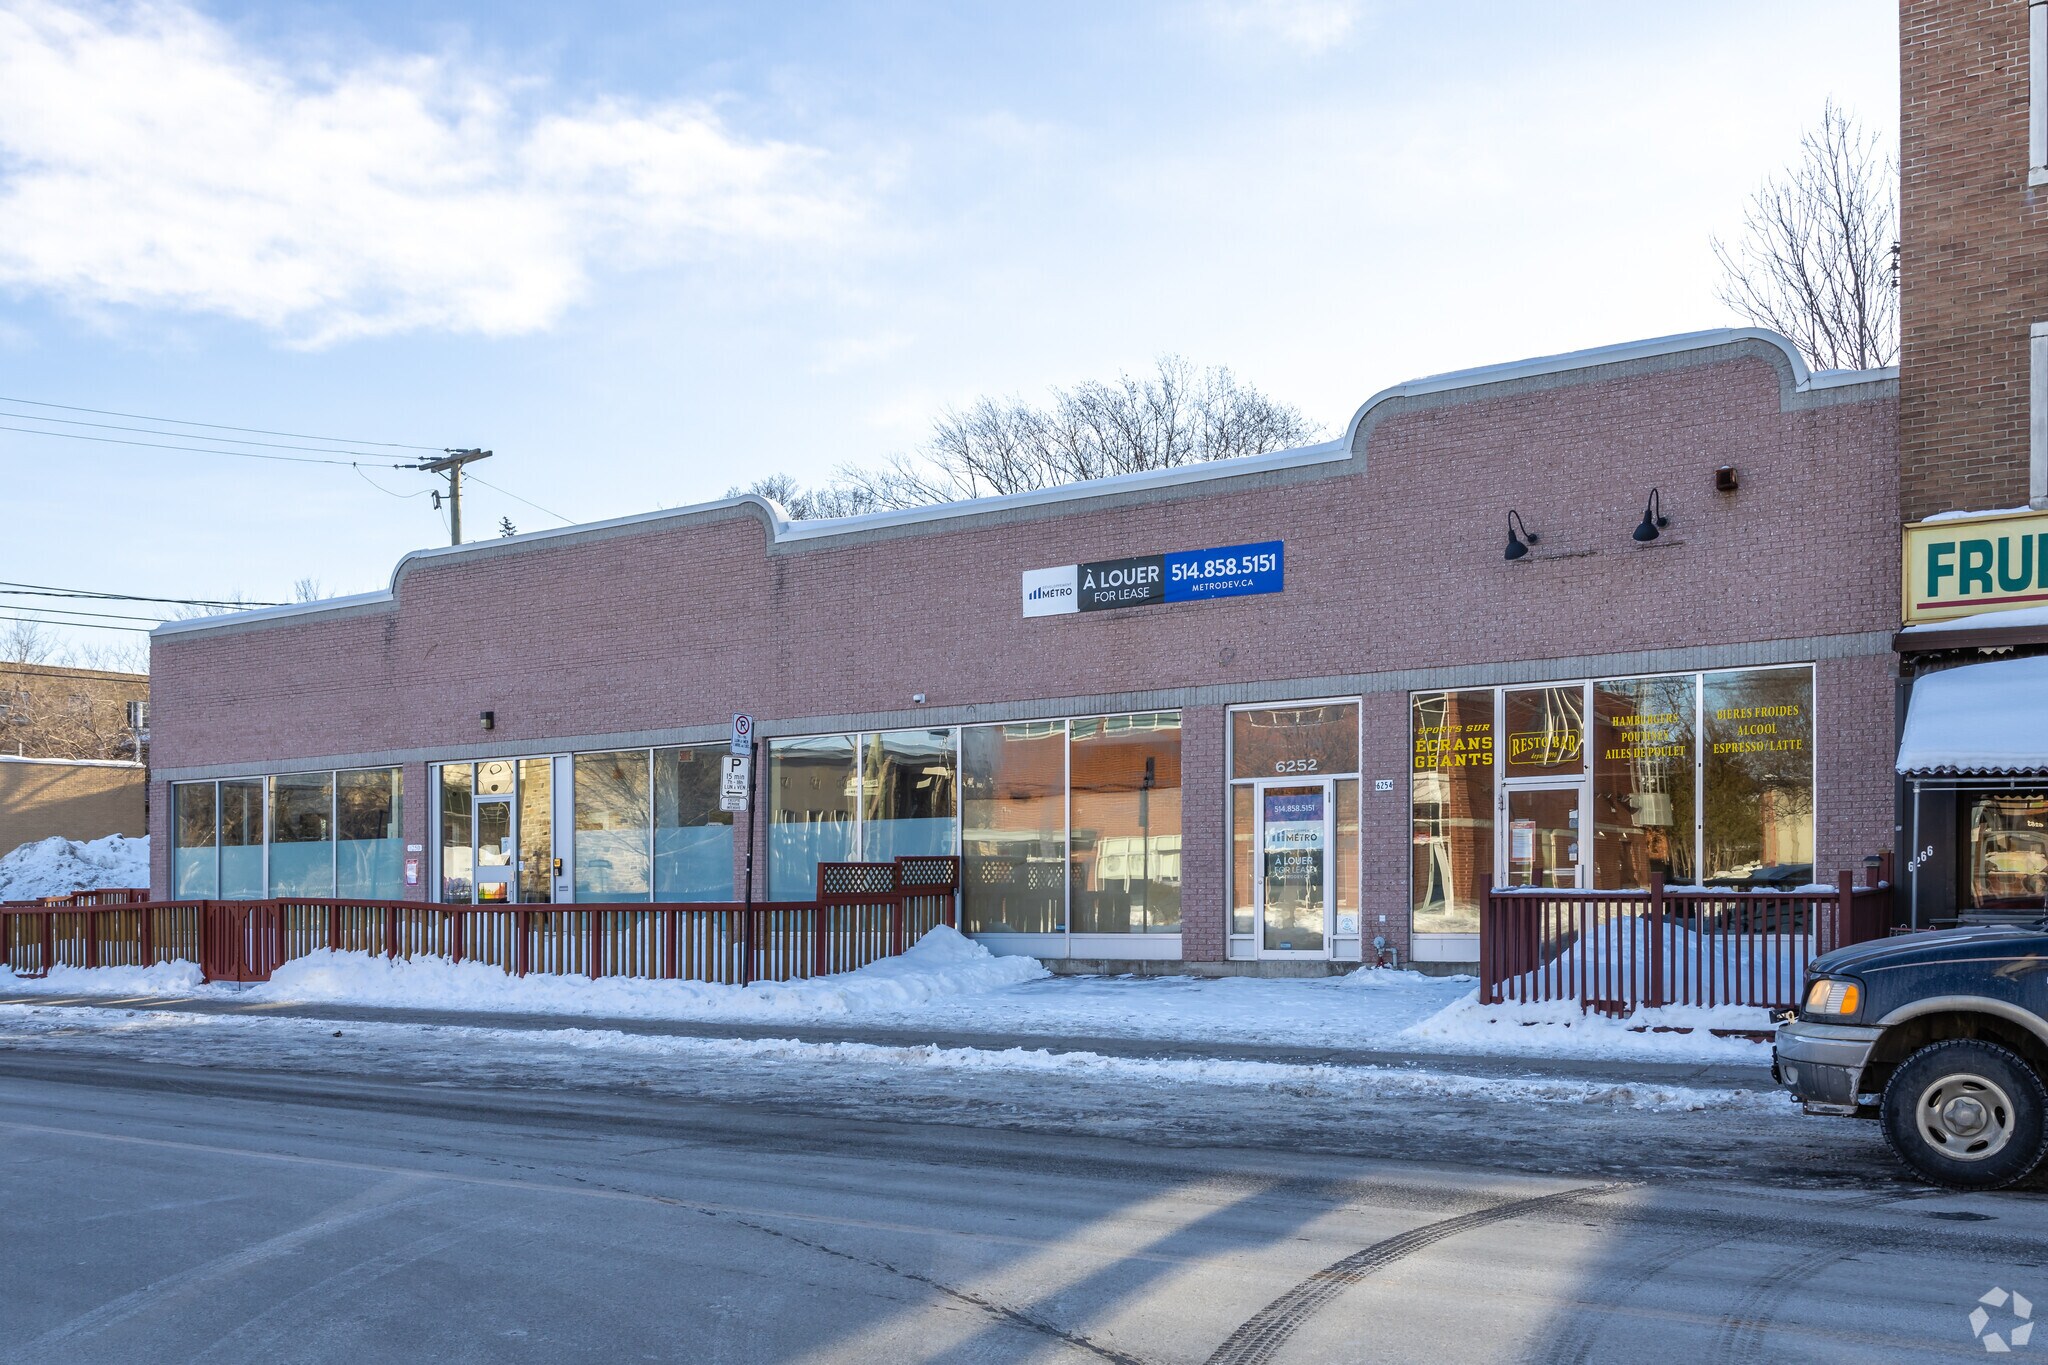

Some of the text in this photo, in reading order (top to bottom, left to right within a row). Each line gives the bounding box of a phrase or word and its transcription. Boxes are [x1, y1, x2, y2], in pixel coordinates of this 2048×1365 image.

[1171, 553, 1276, 581] 514.858.5151
[1083, 565, 1159, 590] À LOUER
[1192, 579, 1254, 592] METRODEV.CA
[1094, 586, 1150, 603] FOR LEASE
[1755, 704, 1799, 718] FROIDES
[1612, 712, 1679, 727] HAMBURGERS
[1418, 723, 1491, 735] SPORTS SUR
[1621, 729, 1669, 743] POUTINES
[1737, 722, 1777, 736] ALCOOL
[1415, 736, 1493, 753] ÉCRANS
[1512, 734, 1576, 757] RESTO BAR
[1713, 739, 1802, 754] ESPRESSO/LATTE
[1605, 745, 1686, 760] AILES DE POULET
[731, 758, 742, 773] P
[1275, 758, 1318, 773] 6252
[1415, 752, 1493, 769] GÉANTS
[1376, 781, 1393, 790] 6254
[1274, 804, 1315, 813] 514.858.5151
[1286, 832, 1318, 842] MÉTRO
[1275, 855, 1313, 865] À LOUER
[1274, 865, 1315, 874] FOR LEASE
